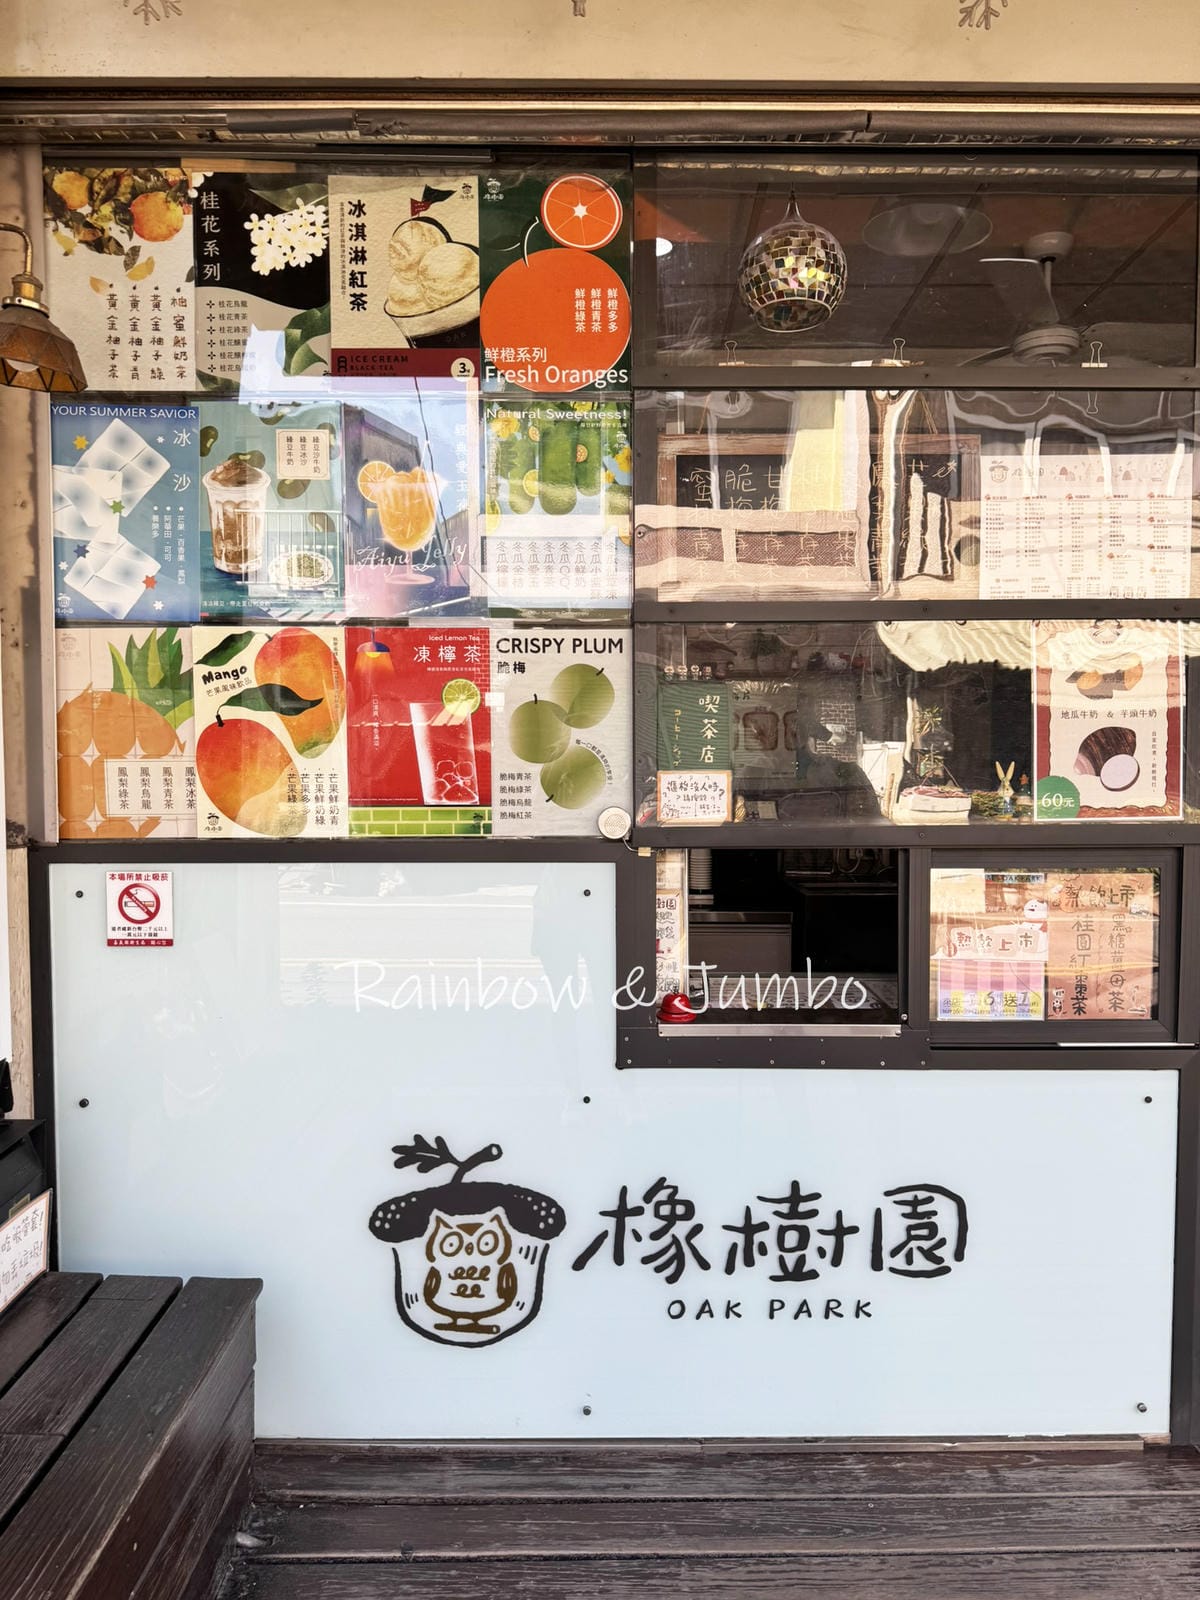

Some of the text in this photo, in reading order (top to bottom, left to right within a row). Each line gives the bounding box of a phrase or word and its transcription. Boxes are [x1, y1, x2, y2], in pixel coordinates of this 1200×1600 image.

[200, 192, 221, 281] 桂花系列
[348, 199, 367, 311] 冰淇淋紅茶
[575, 288, 586, 333] 鮮橙綠茶
[591, 288, 602, 333] 鮮橙青茶
[607, 288, 618, 333] 鮮橙多多
[350, 355, 408, 363] ICE CREAM
[484, 347, 547, 363] 鮮橙系列
[485, 366, 628, 388] Fresh Oranges
[51, 405, 196, 420] YOUR SUMMER SAVIOR
[486, 407, 627, 421] Natural Sweetness!
[172, 428, 192, 493] 冰沙
[413, 645, 481, 663] 凍檸茶
[496, 638, 623, 654] CRISPY PLUM
[202, 665, 247, 685] Mango
[497, 661, 526, 674] 脆梅
[1061, 709, 1158, 720] 地瓜牛奶 & 芋頭牛奶
[699, 694, 720, 763] 喫茶店
[1041, 792, 1075, 808] 60元
[109, 873, 168, 881] 本場所禁止吸菸
[573, 1177, 968, 1284] 橡樹園
[667, 1298, 872, 1320] OAK PARK
